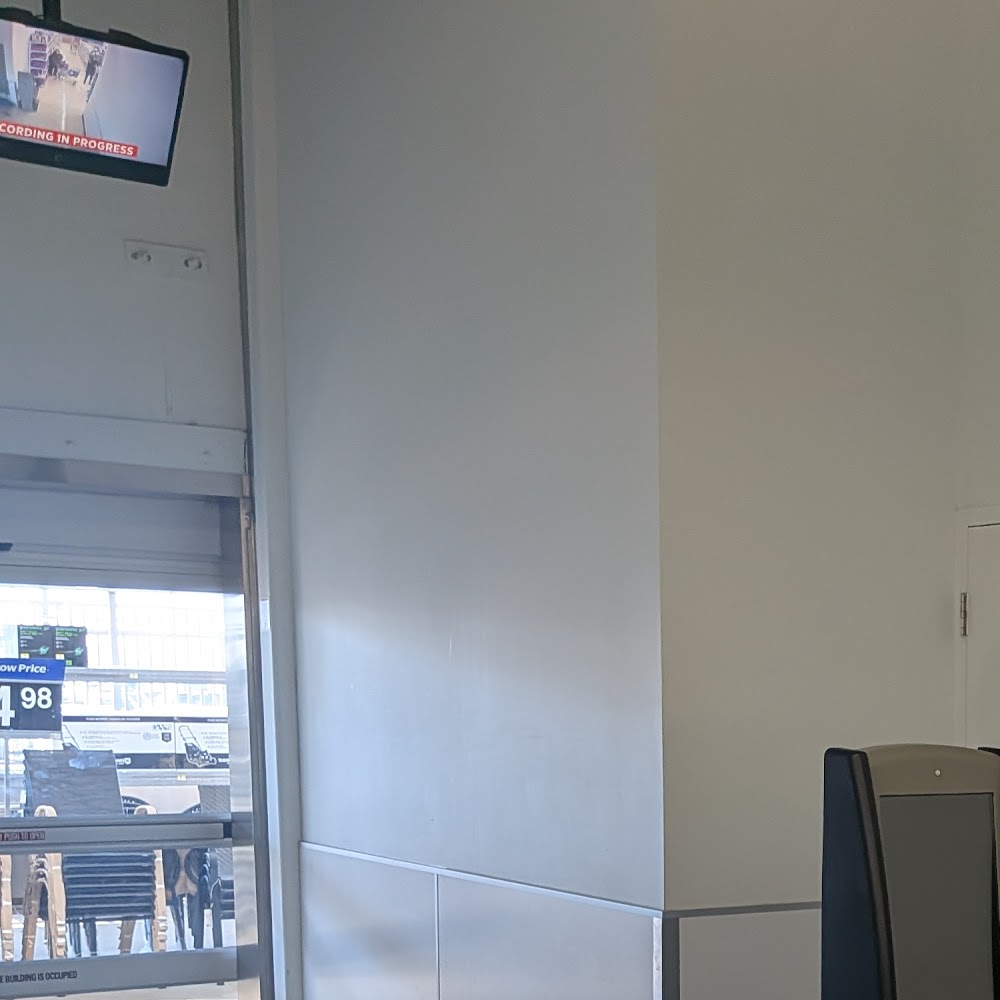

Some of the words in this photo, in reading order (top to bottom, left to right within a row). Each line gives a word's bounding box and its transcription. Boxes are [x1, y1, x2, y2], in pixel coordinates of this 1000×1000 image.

[57, 133, 70, 145] IN
[73, 136, 134, 156] PROGRESS
[18, 664, 47, 674] Price
[20, 687, 52, 710] 98
[5, 973, 37, 983] BUILDING
[38, 972, 44, 981] IS
[45, 971, 78, 980] OCCUPIED
